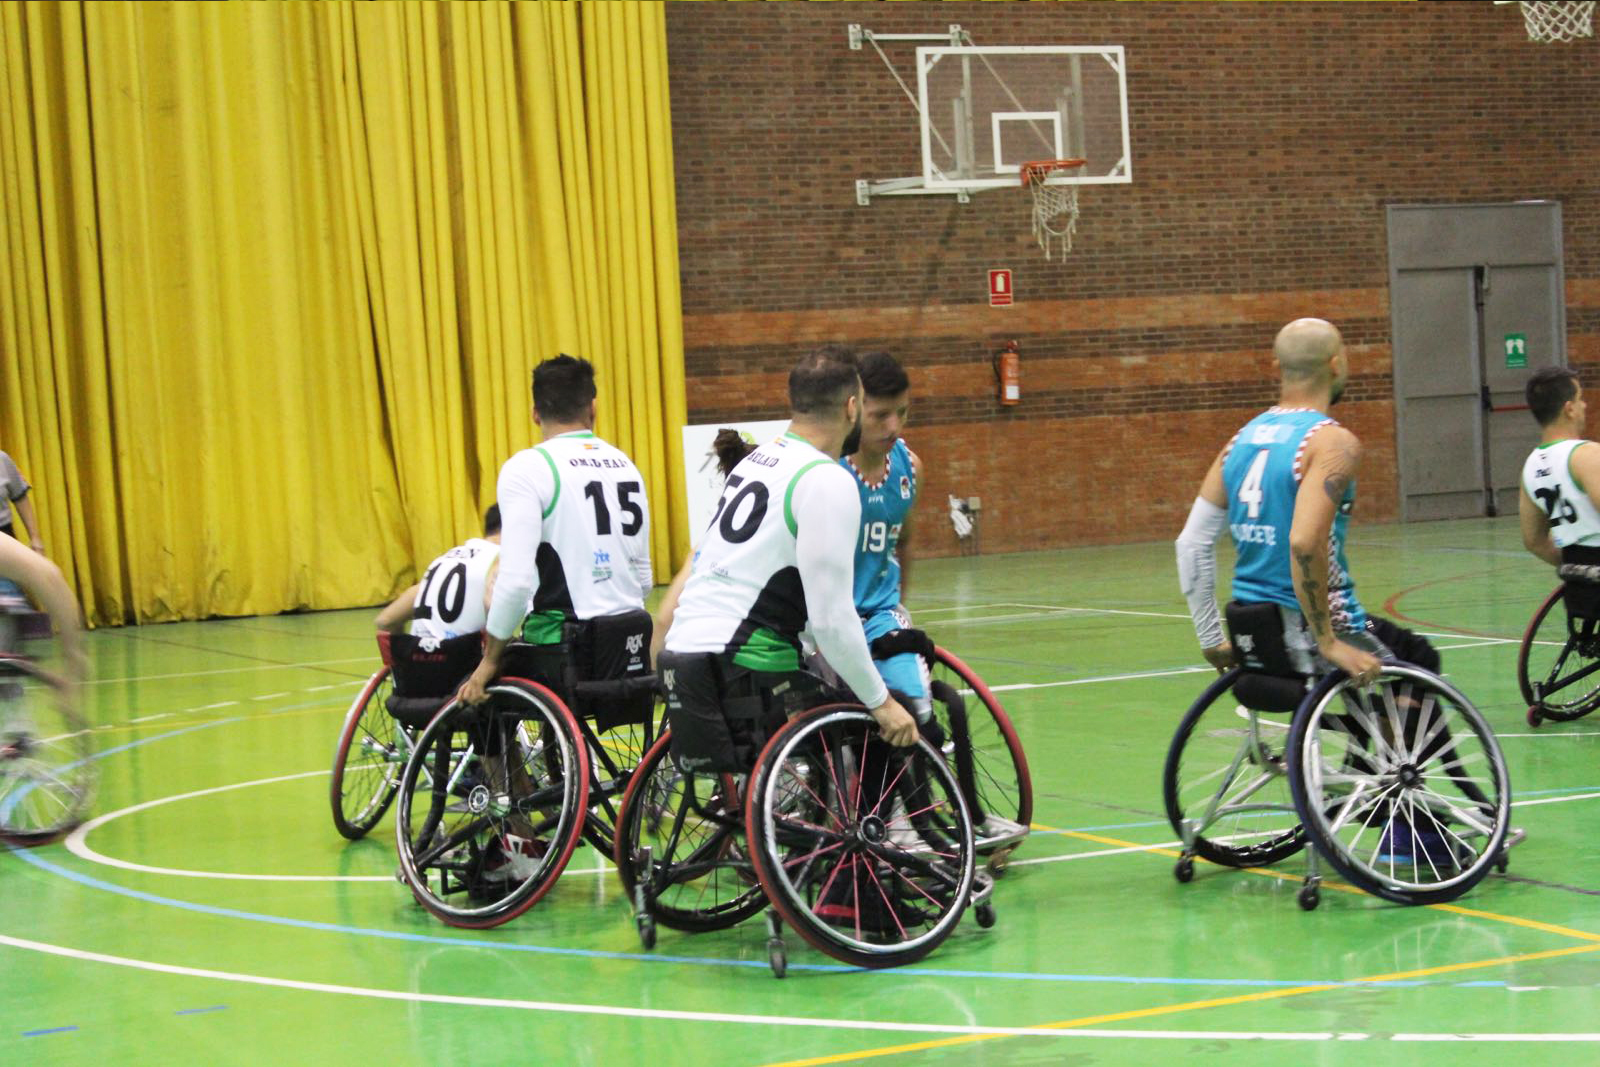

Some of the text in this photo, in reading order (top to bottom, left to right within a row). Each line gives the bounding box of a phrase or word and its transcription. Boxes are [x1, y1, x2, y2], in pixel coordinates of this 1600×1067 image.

[584, 480, 643, 537] 15
[1238, 448, 1270, 519] 4
[862, 521, 887, 553] 19
[414, 561, 467, 624] 10
